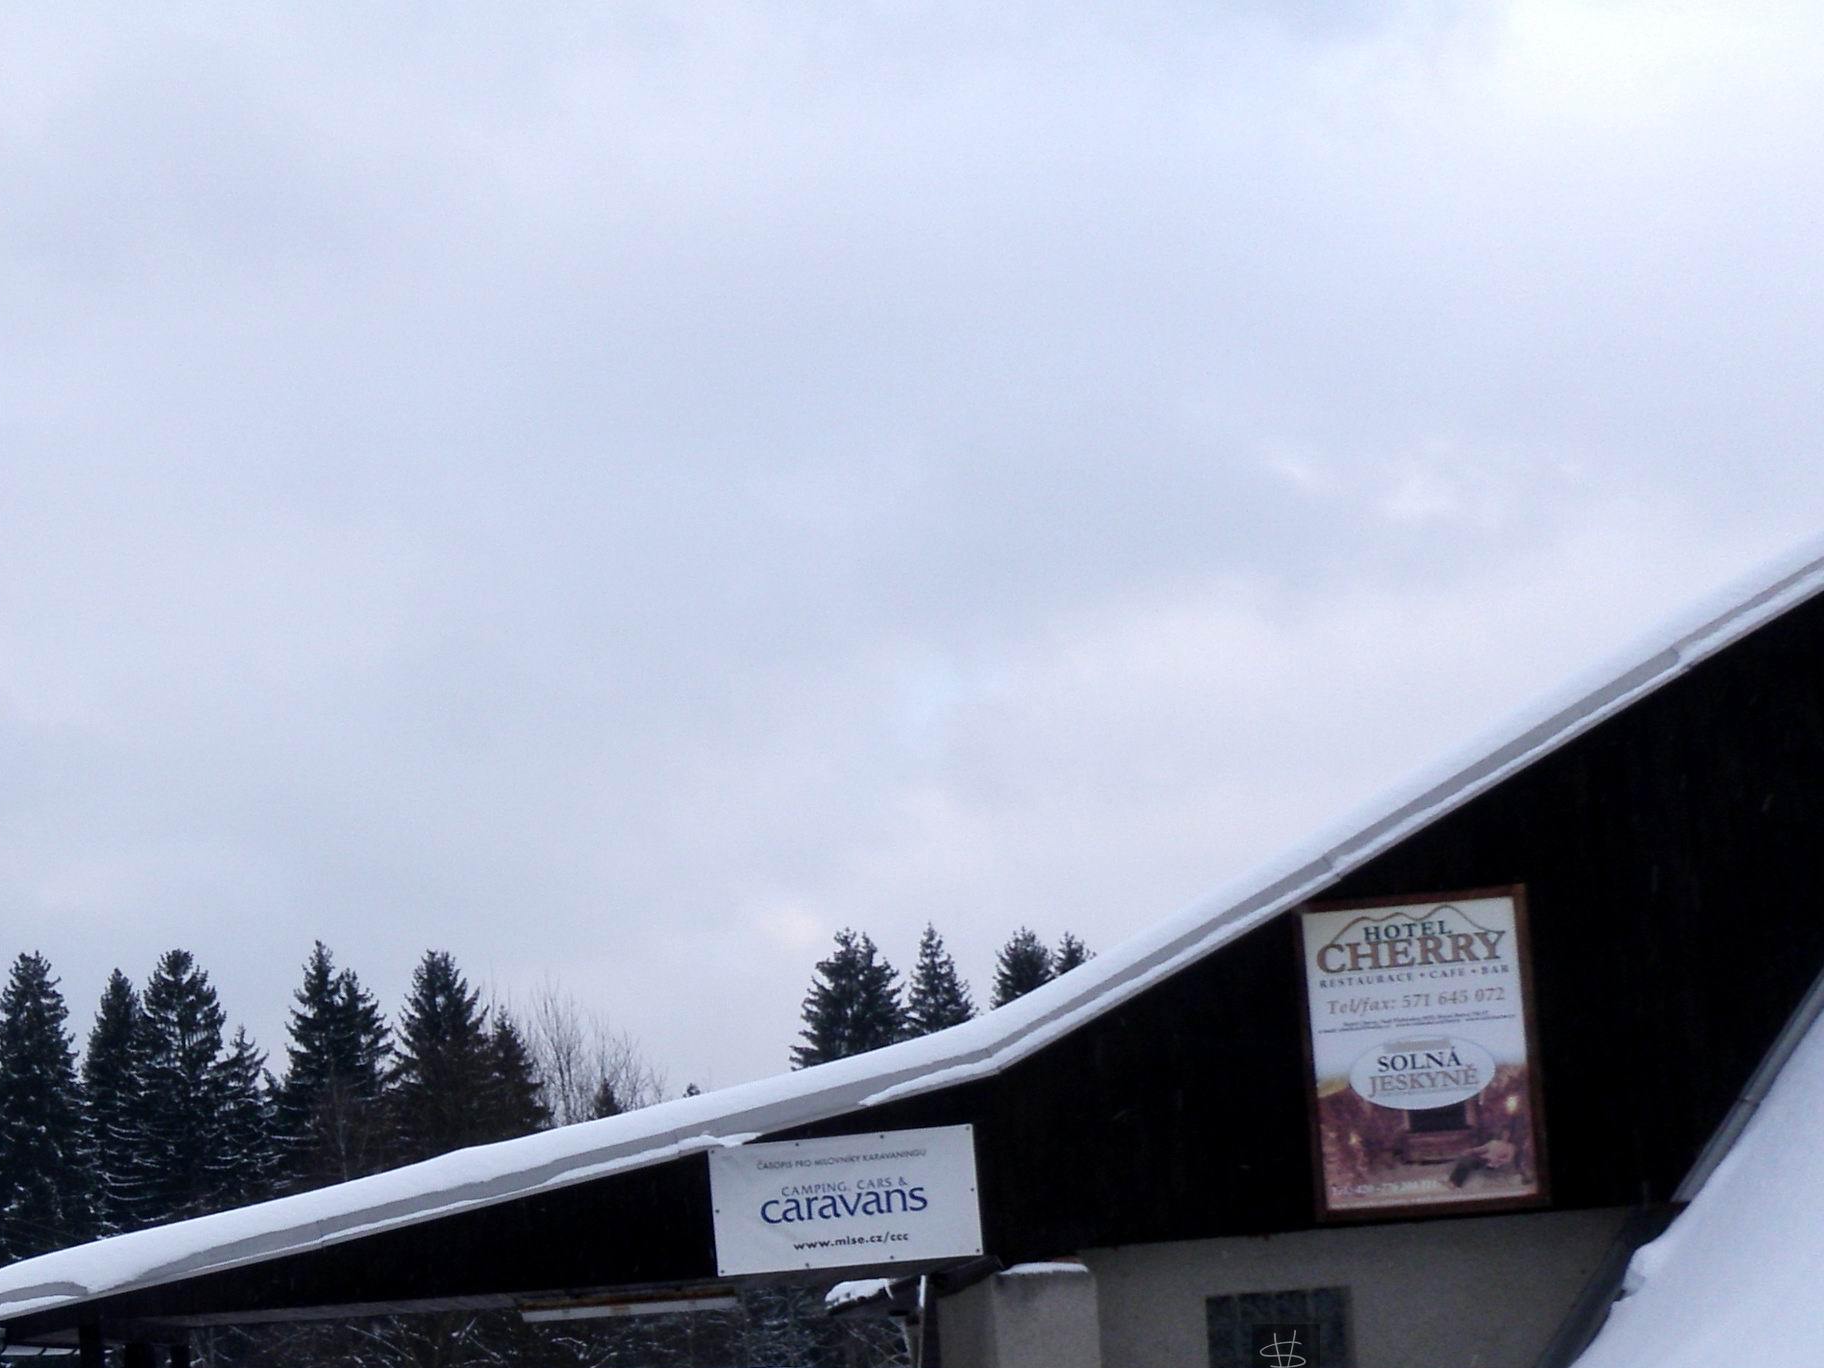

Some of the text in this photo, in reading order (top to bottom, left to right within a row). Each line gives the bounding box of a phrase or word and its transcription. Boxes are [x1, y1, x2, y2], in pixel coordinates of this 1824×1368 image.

[1363, 920, 1452, 941] HOTEL
[1316, 931, 1506, 974] CHERRY
[1319, 972, 1413, 989] RESTAURACE
[1481, 964, 1509, 974] BAR
[1377, 1046, 1462, 1073] SOLNÁ
[1368, 1063, 1479, 1098] JESKYNĚ
[856, 1176, 892, 1190] CARS
[898, 1175, 909, 1187] &
[760, 1186, 928, 1224] caravans
